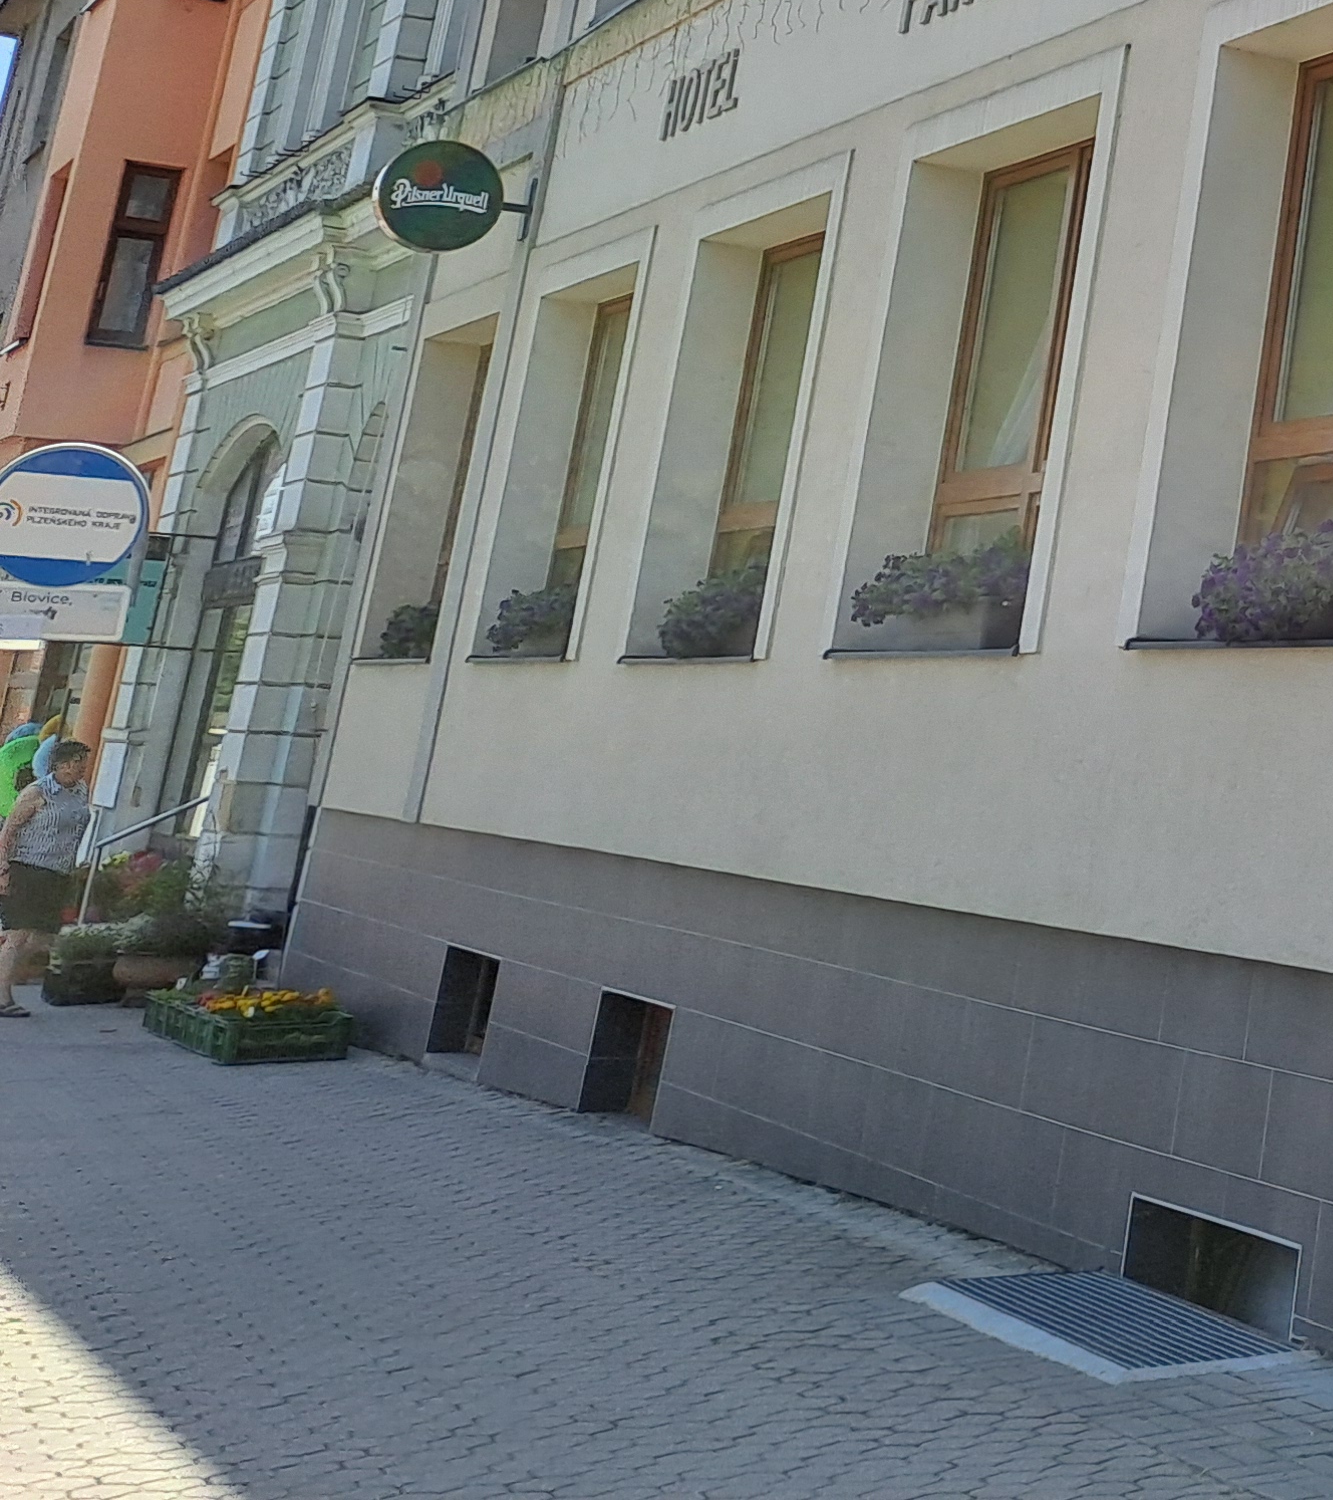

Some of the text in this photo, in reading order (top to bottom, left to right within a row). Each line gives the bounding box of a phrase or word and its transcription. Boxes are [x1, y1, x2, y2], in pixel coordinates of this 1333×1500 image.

[659, 47, 741, 143] HOTEL
[390, 178, 489, 211] Pilsner Urquell
[10, 591, 73, 606] Blovice,
